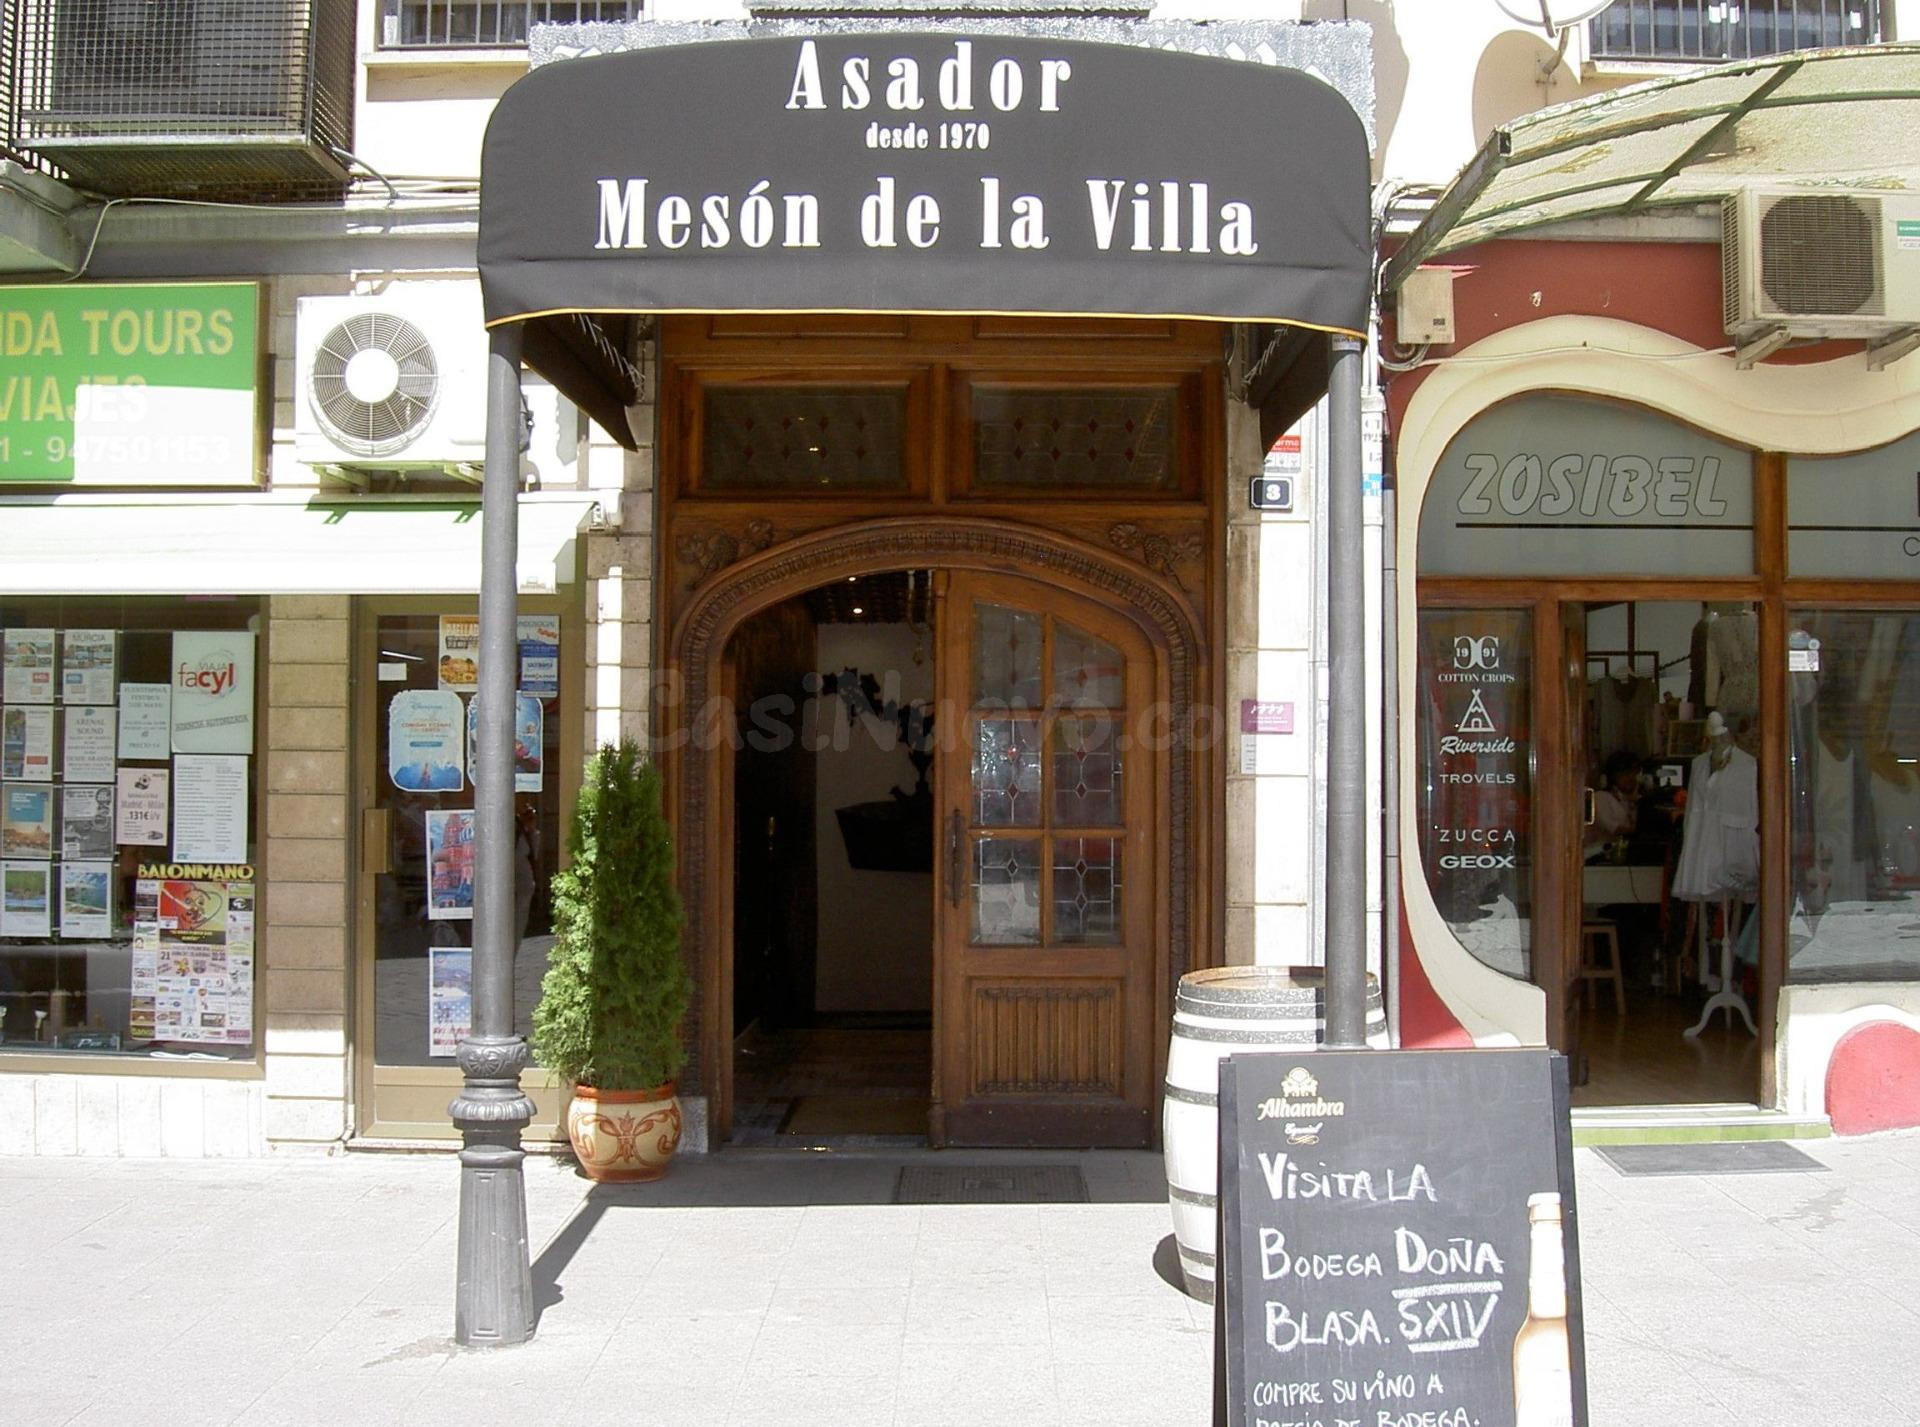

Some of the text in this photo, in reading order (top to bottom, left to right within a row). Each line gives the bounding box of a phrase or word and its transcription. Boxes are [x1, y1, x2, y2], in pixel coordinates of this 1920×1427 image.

[785, 40, 1071, 112] Asador
[866, 122, 990, 149] desde 1970
[594, 178, 1258, 255] Mesón de la Villa
[0, 309, 234, 356] DA TOURS
[1265, 483, 1281, 501] 3
[1457, 453, 1727, 517] ZOSIBEL
[177, 662, 234, 694] facyl
[1438, 673, 1515, 682] COTTON CROPS
[1440, 736, 1516, 755] Riverside
[1439, 773, 1516, 784] TROVELS
[1439, 829, 1516, 842] ZUCCA
[138, 864, 254, 880] BALONMANO
[1439, 855, 1515, 869] GEOX
[1257, 1097, 1345, 1121] Alhambra
[1386, 1163, 1438, 1202] LA
[1265, 1300, 1391, 1353] BLASA.
[1253, 1381, 1324, 1407] COMPRE
[1331, 1378, 1357, 1402] SU
[1426, 1373, 1444, 1396] A
